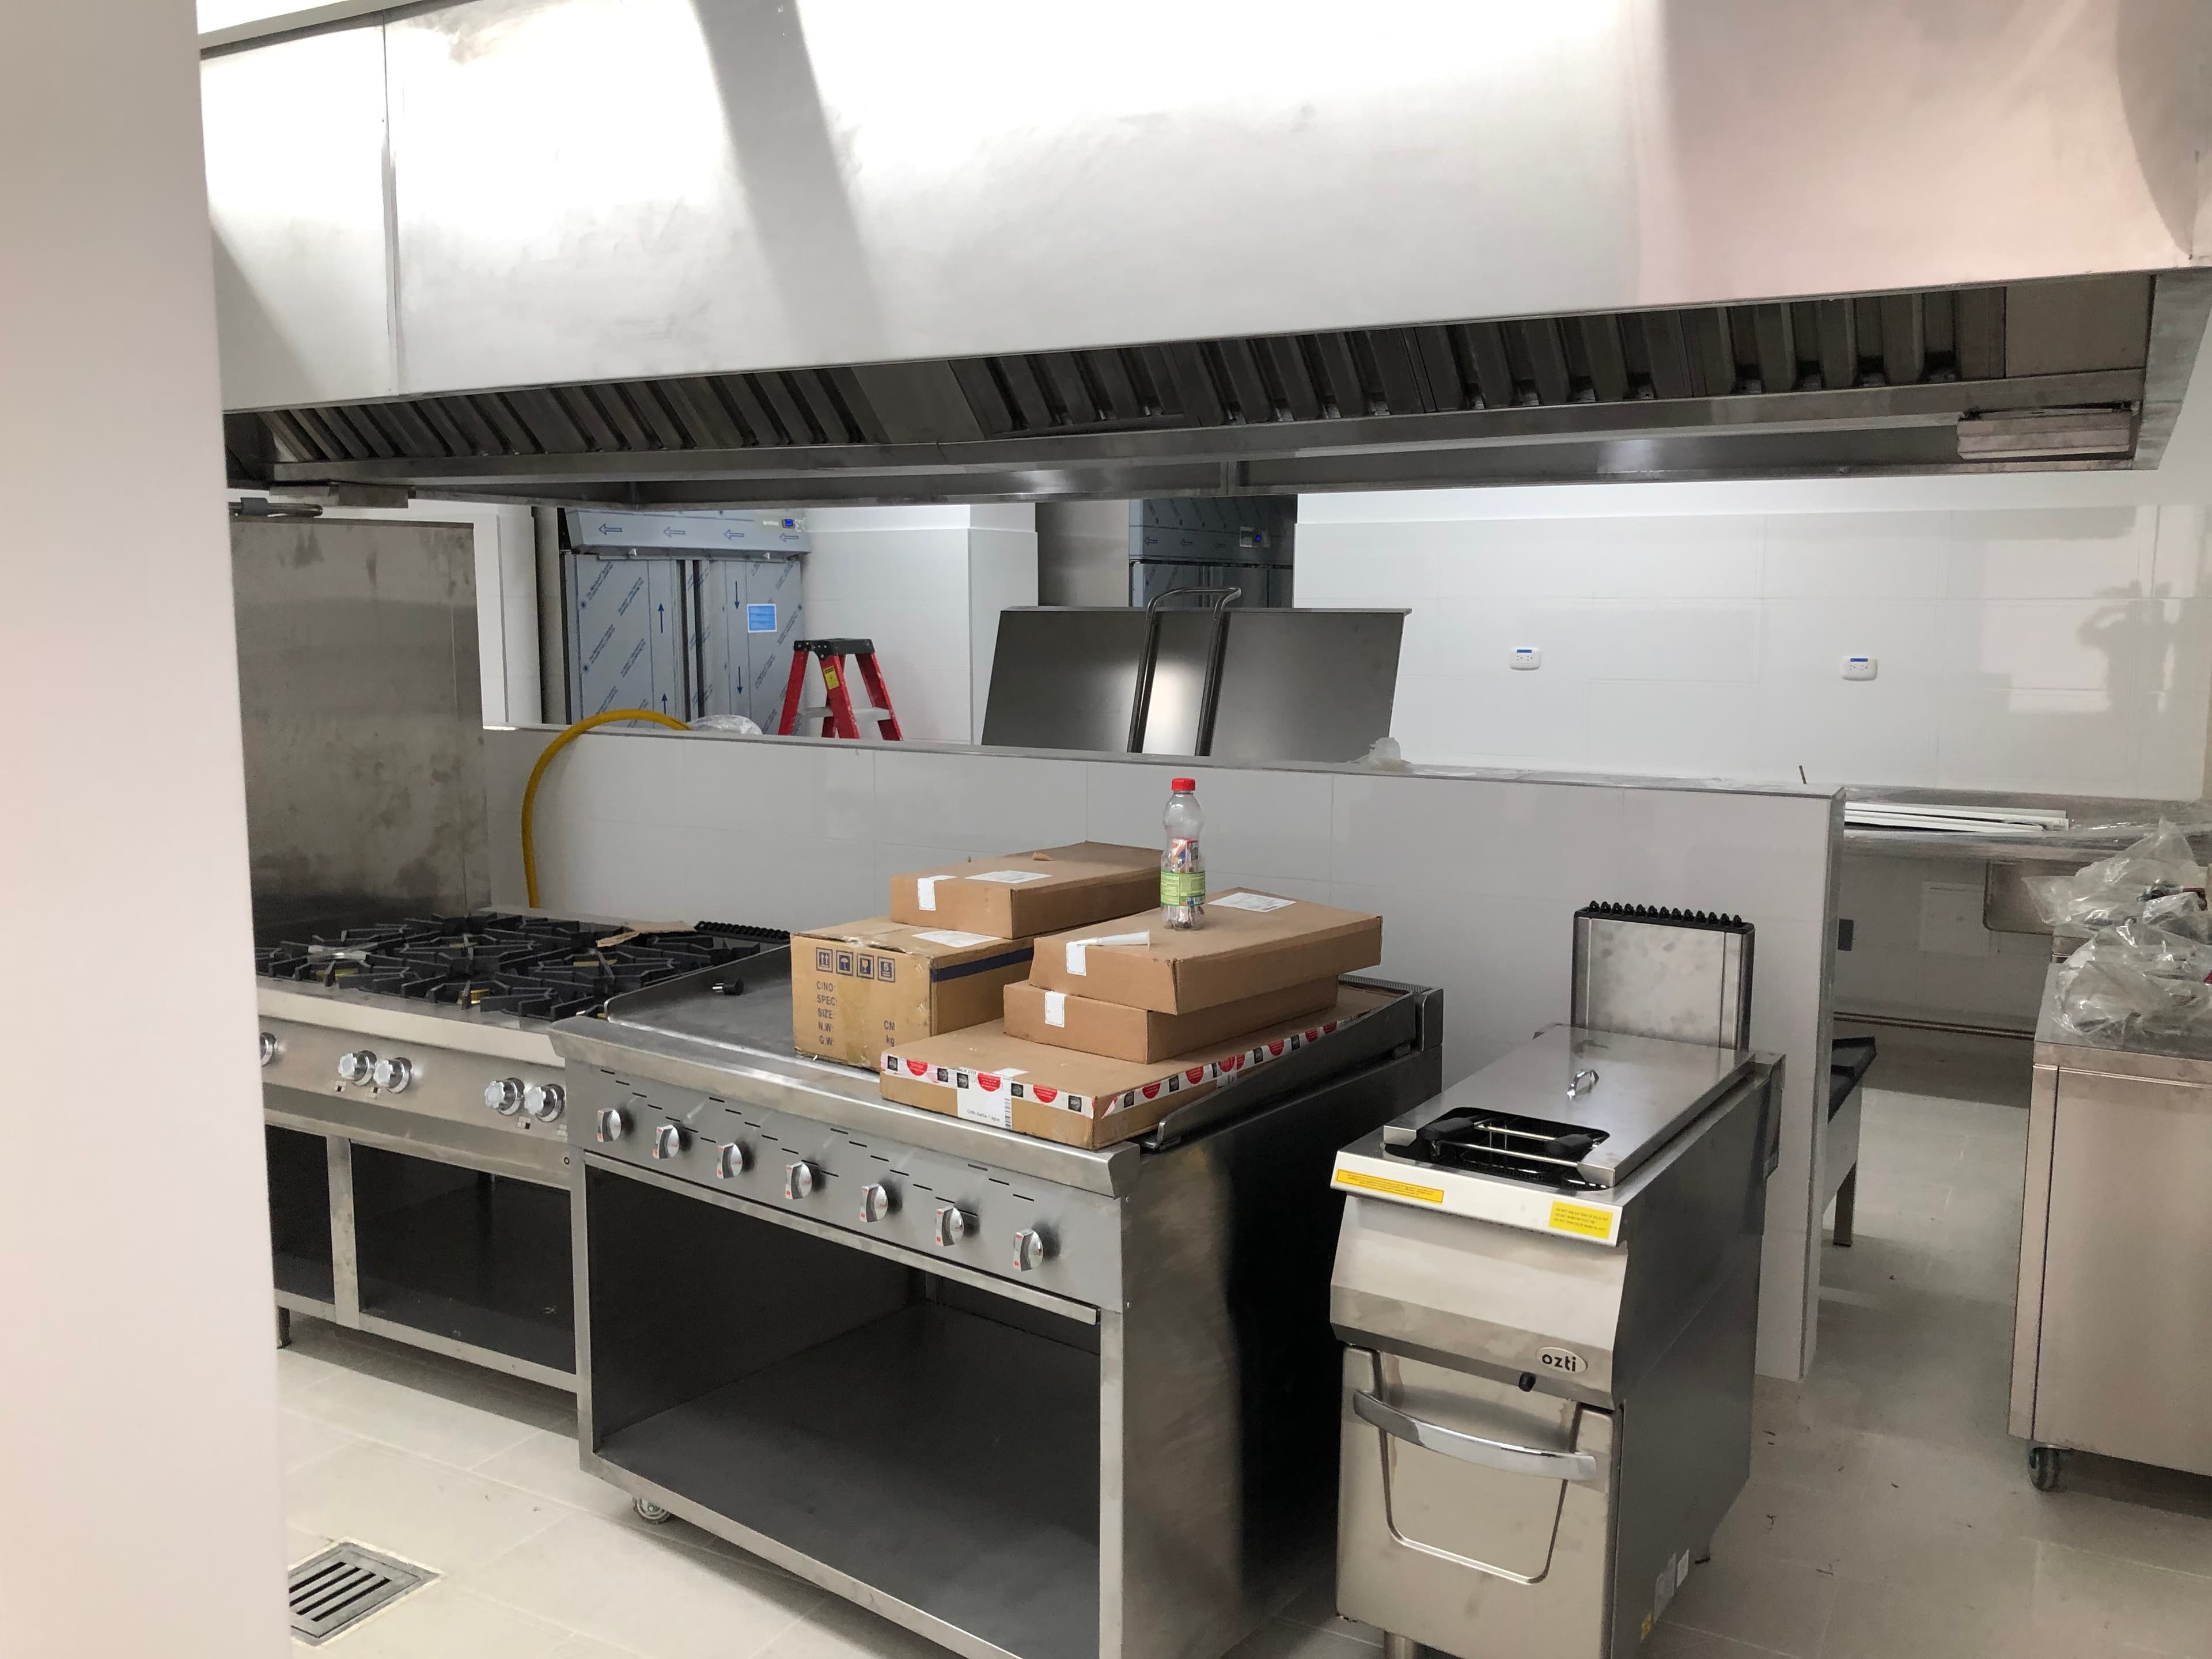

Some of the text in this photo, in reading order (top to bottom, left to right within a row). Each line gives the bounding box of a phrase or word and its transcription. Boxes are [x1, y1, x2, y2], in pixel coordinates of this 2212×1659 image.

[884, 1020, 895, 1031] CM
[886, 1035, 895, 1047] kg
[1541, 1354, 1576, 1372] ozti
